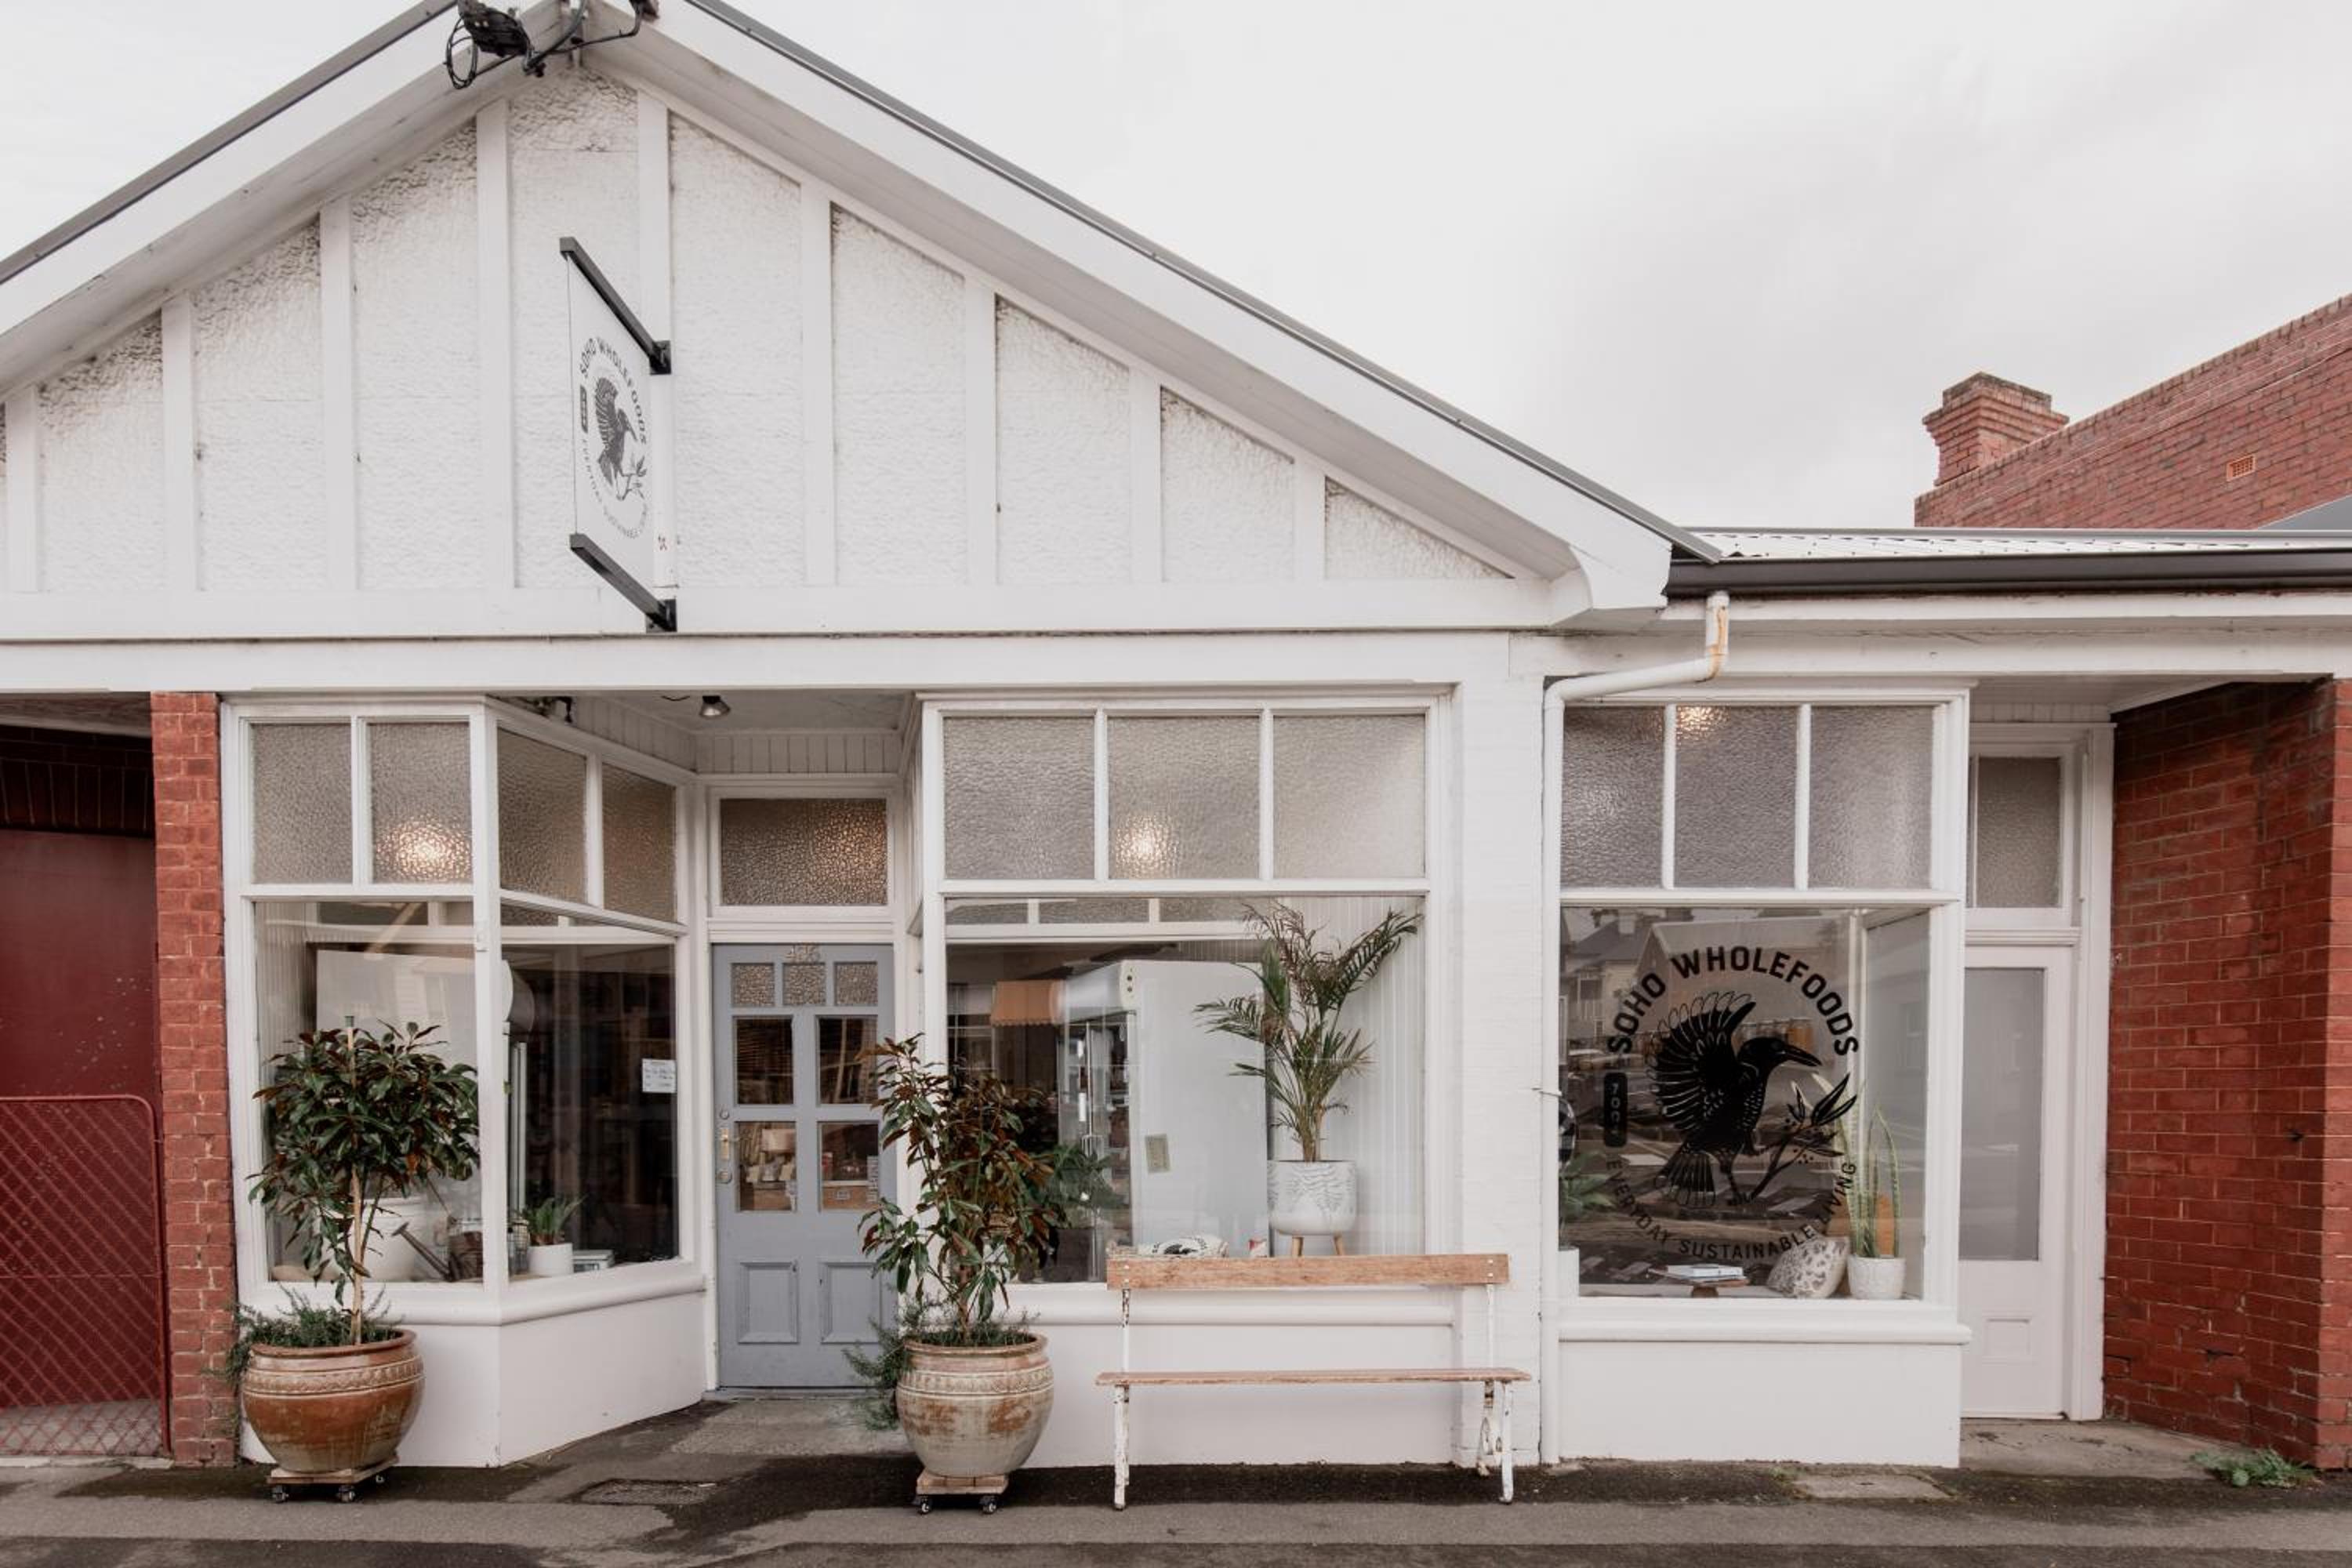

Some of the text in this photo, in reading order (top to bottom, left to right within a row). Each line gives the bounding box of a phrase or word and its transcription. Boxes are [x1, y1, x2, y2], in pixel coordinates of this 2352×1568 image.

[1608, 946, 1859, 1056] SOHO WHOLEFOODS
[1606, 1160, 1857, 1260] EVERYDAY SUSTAINABLE LIVING
